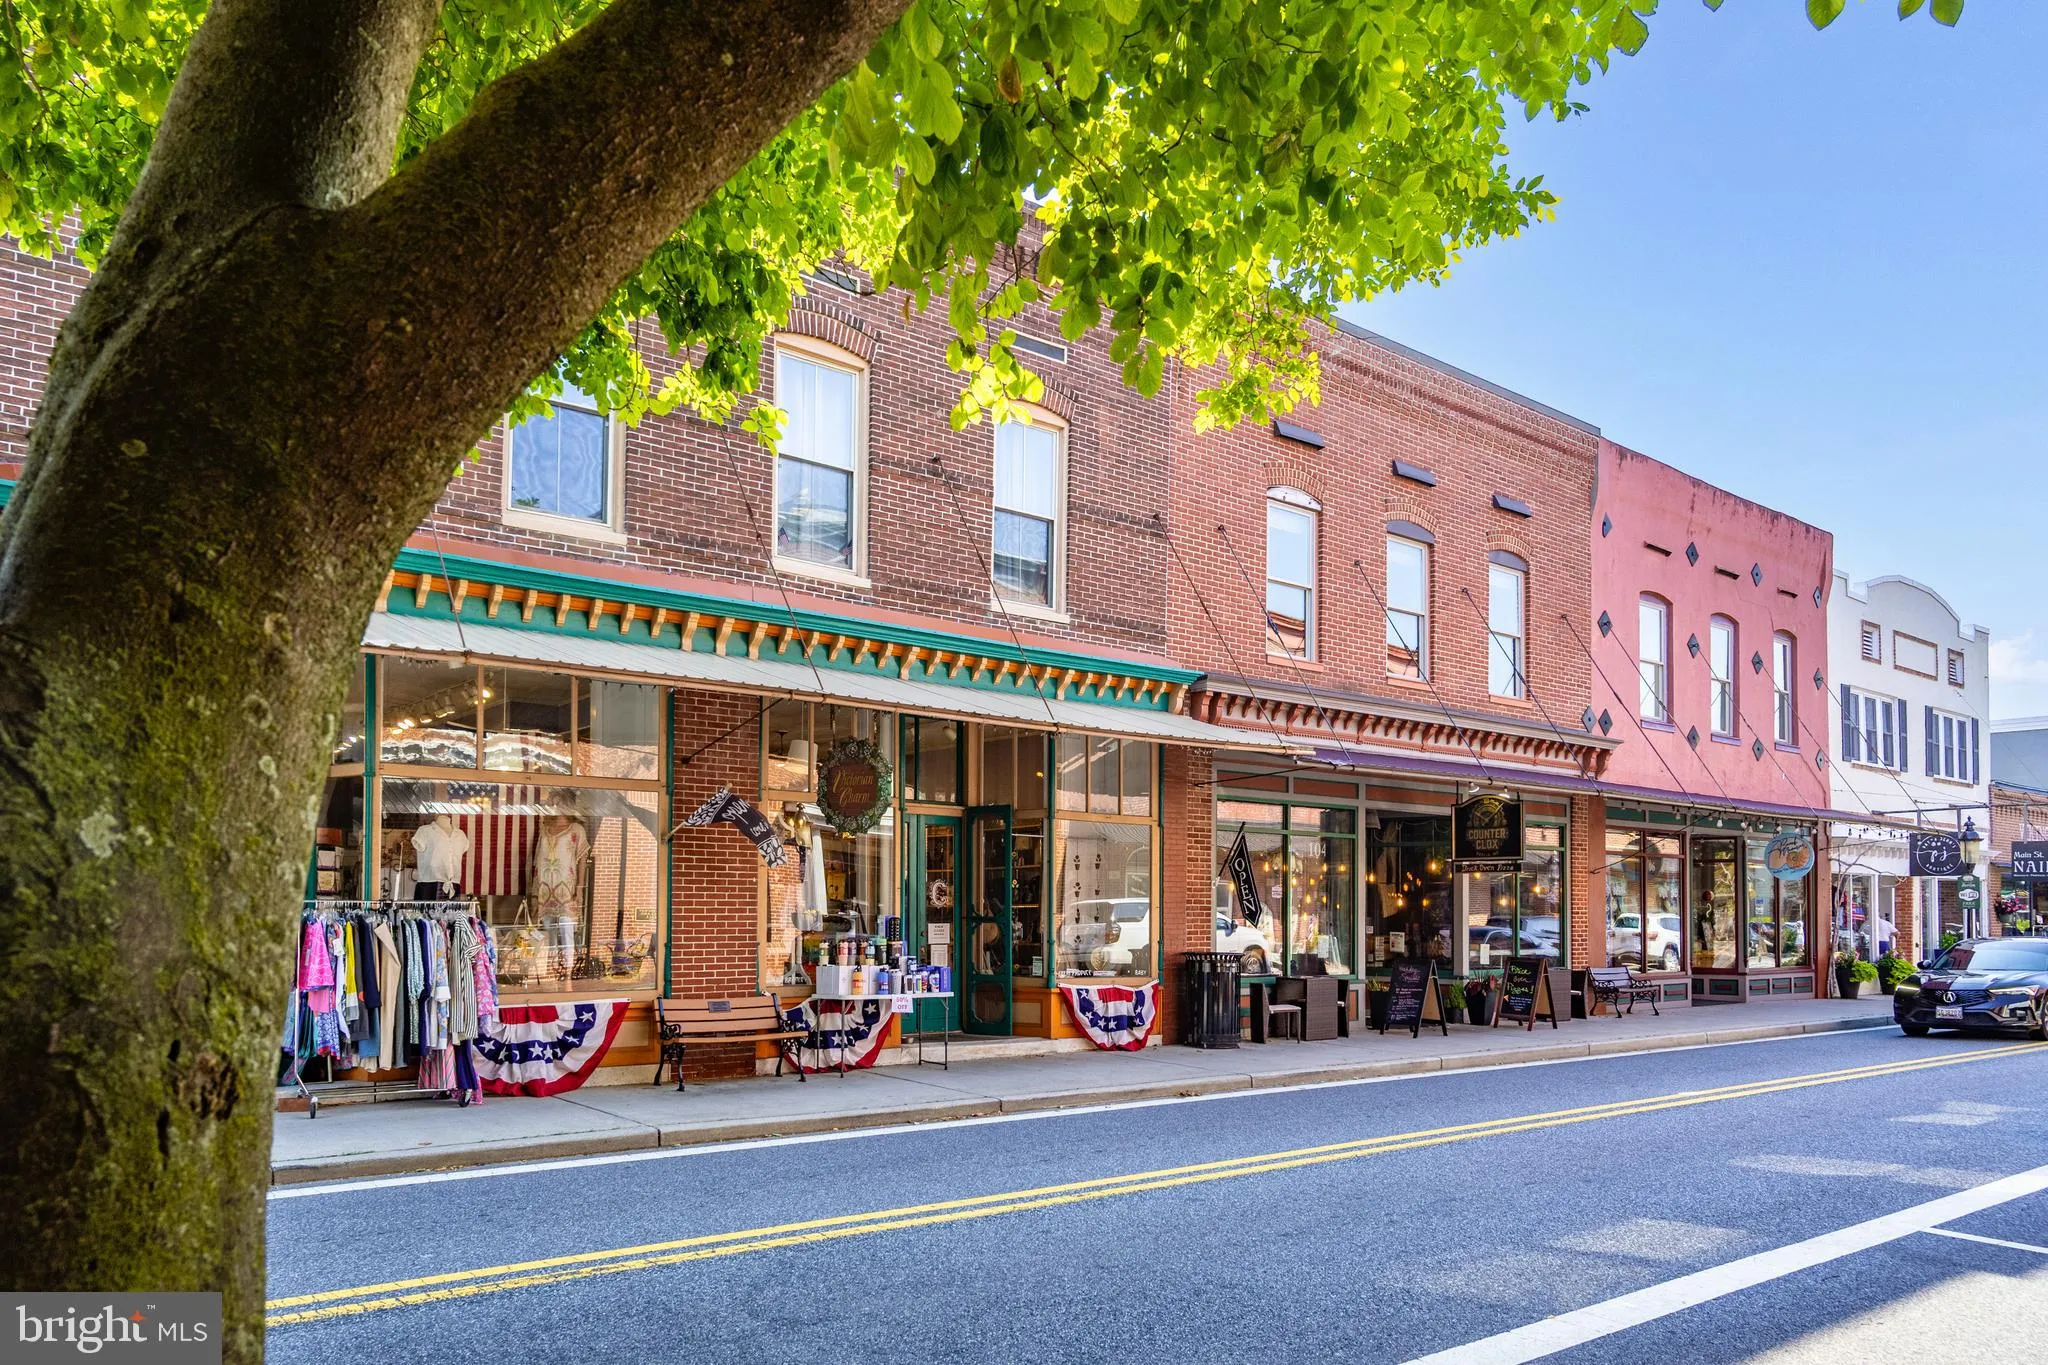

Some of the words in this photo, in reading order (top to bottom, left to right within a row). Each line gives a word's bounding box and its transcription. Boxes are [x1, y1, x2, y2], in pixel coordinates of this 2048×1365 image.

[833, 769, 874, 794] Victorian
[840, 787, 870, 808] Charm
[1468, 828, 1506, 840] COUNTER
[1309, 842, 1326, 858] 104
[1476, 840, 1498, 850] CLOX
[2013, 851, 2032, 860] Main
[1462, 863, 1479, 872] Brick
[1480, 863, 1495, 871] Oven
[1497, 863, 1514, 871] Pizza
[2013, 860, 2048, 873] NAI
[1235, 857, 1257, 914] OPEN
